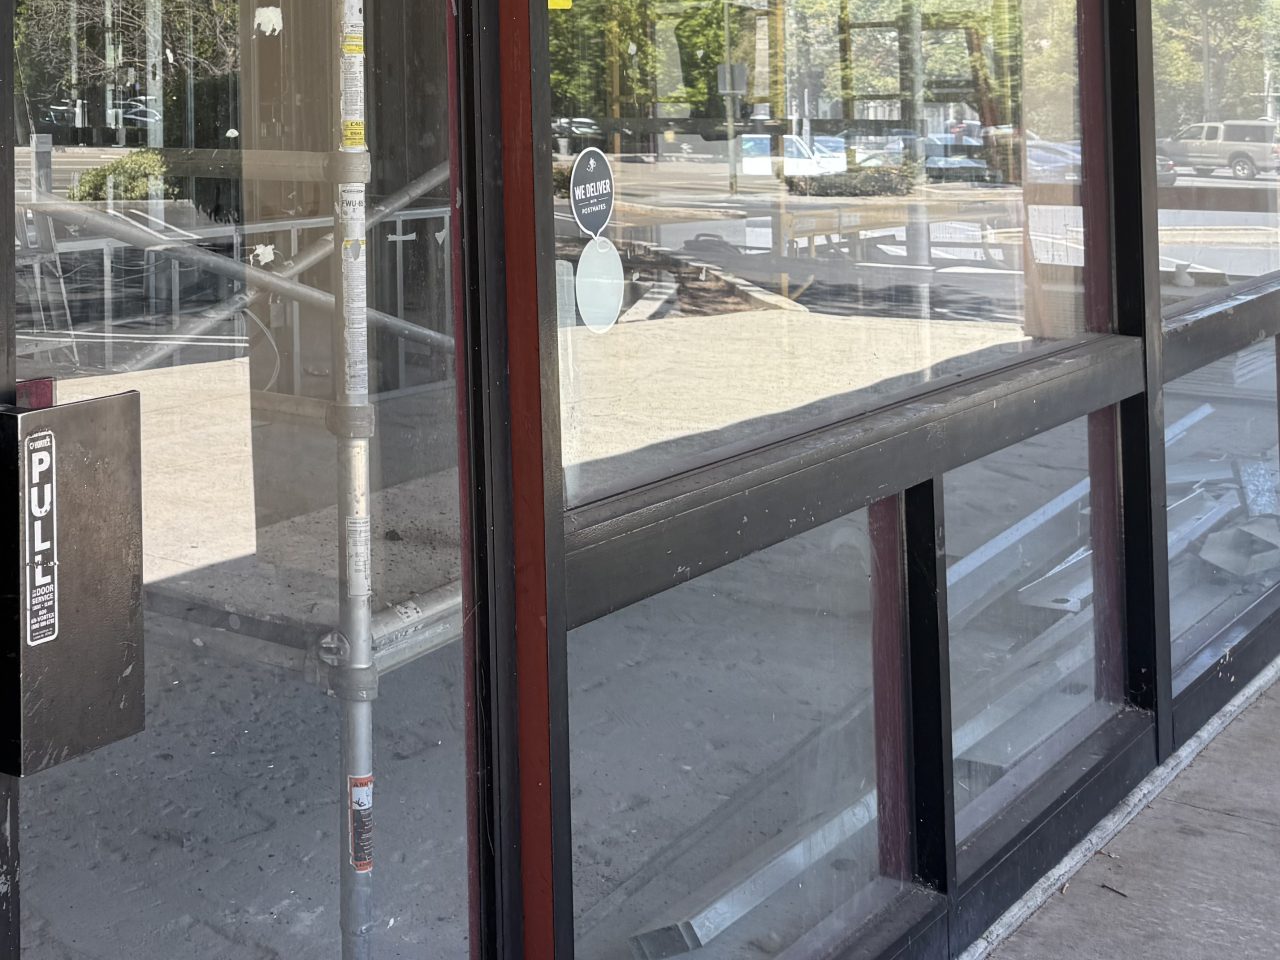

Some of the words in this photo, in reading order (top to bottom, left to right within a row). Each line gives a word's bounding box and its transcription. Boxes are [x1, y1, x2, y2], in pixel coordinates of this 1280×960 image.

[574, 184, 586, 201] WE
[585, 178, 611, 198] DELIVER
[581, 203, 606, 215] POSTMATES
[30, 450, 51, 587] PULL
[36, 584, 54, 596] DOOR
[31, 593, 54, 605] SERVICE
